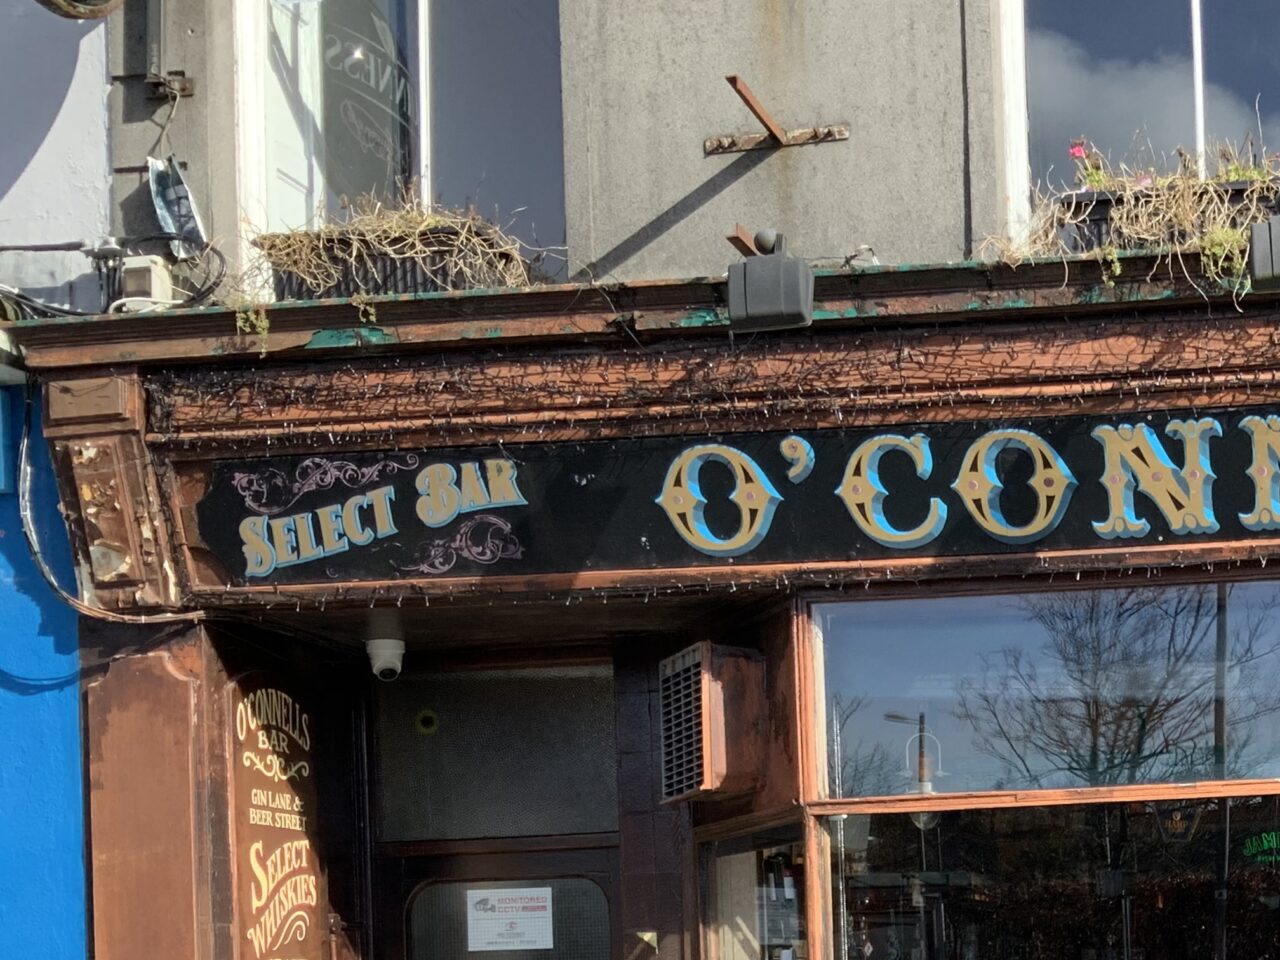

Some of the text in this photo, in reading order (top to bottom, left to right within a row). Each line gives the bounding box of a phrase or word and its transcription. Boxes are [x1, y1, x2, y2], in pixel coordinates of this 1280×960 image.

[239, 458, 529, 577] SELECT BAR
[257, 729, 290, 754] BAR
[249, 807, 307, 832] BEER STREET
[251, 788, 305, 812] GIN LANE &
[249, 839, 310, 914] SELECT
[246, 874, 317, 959] WHISKIES
